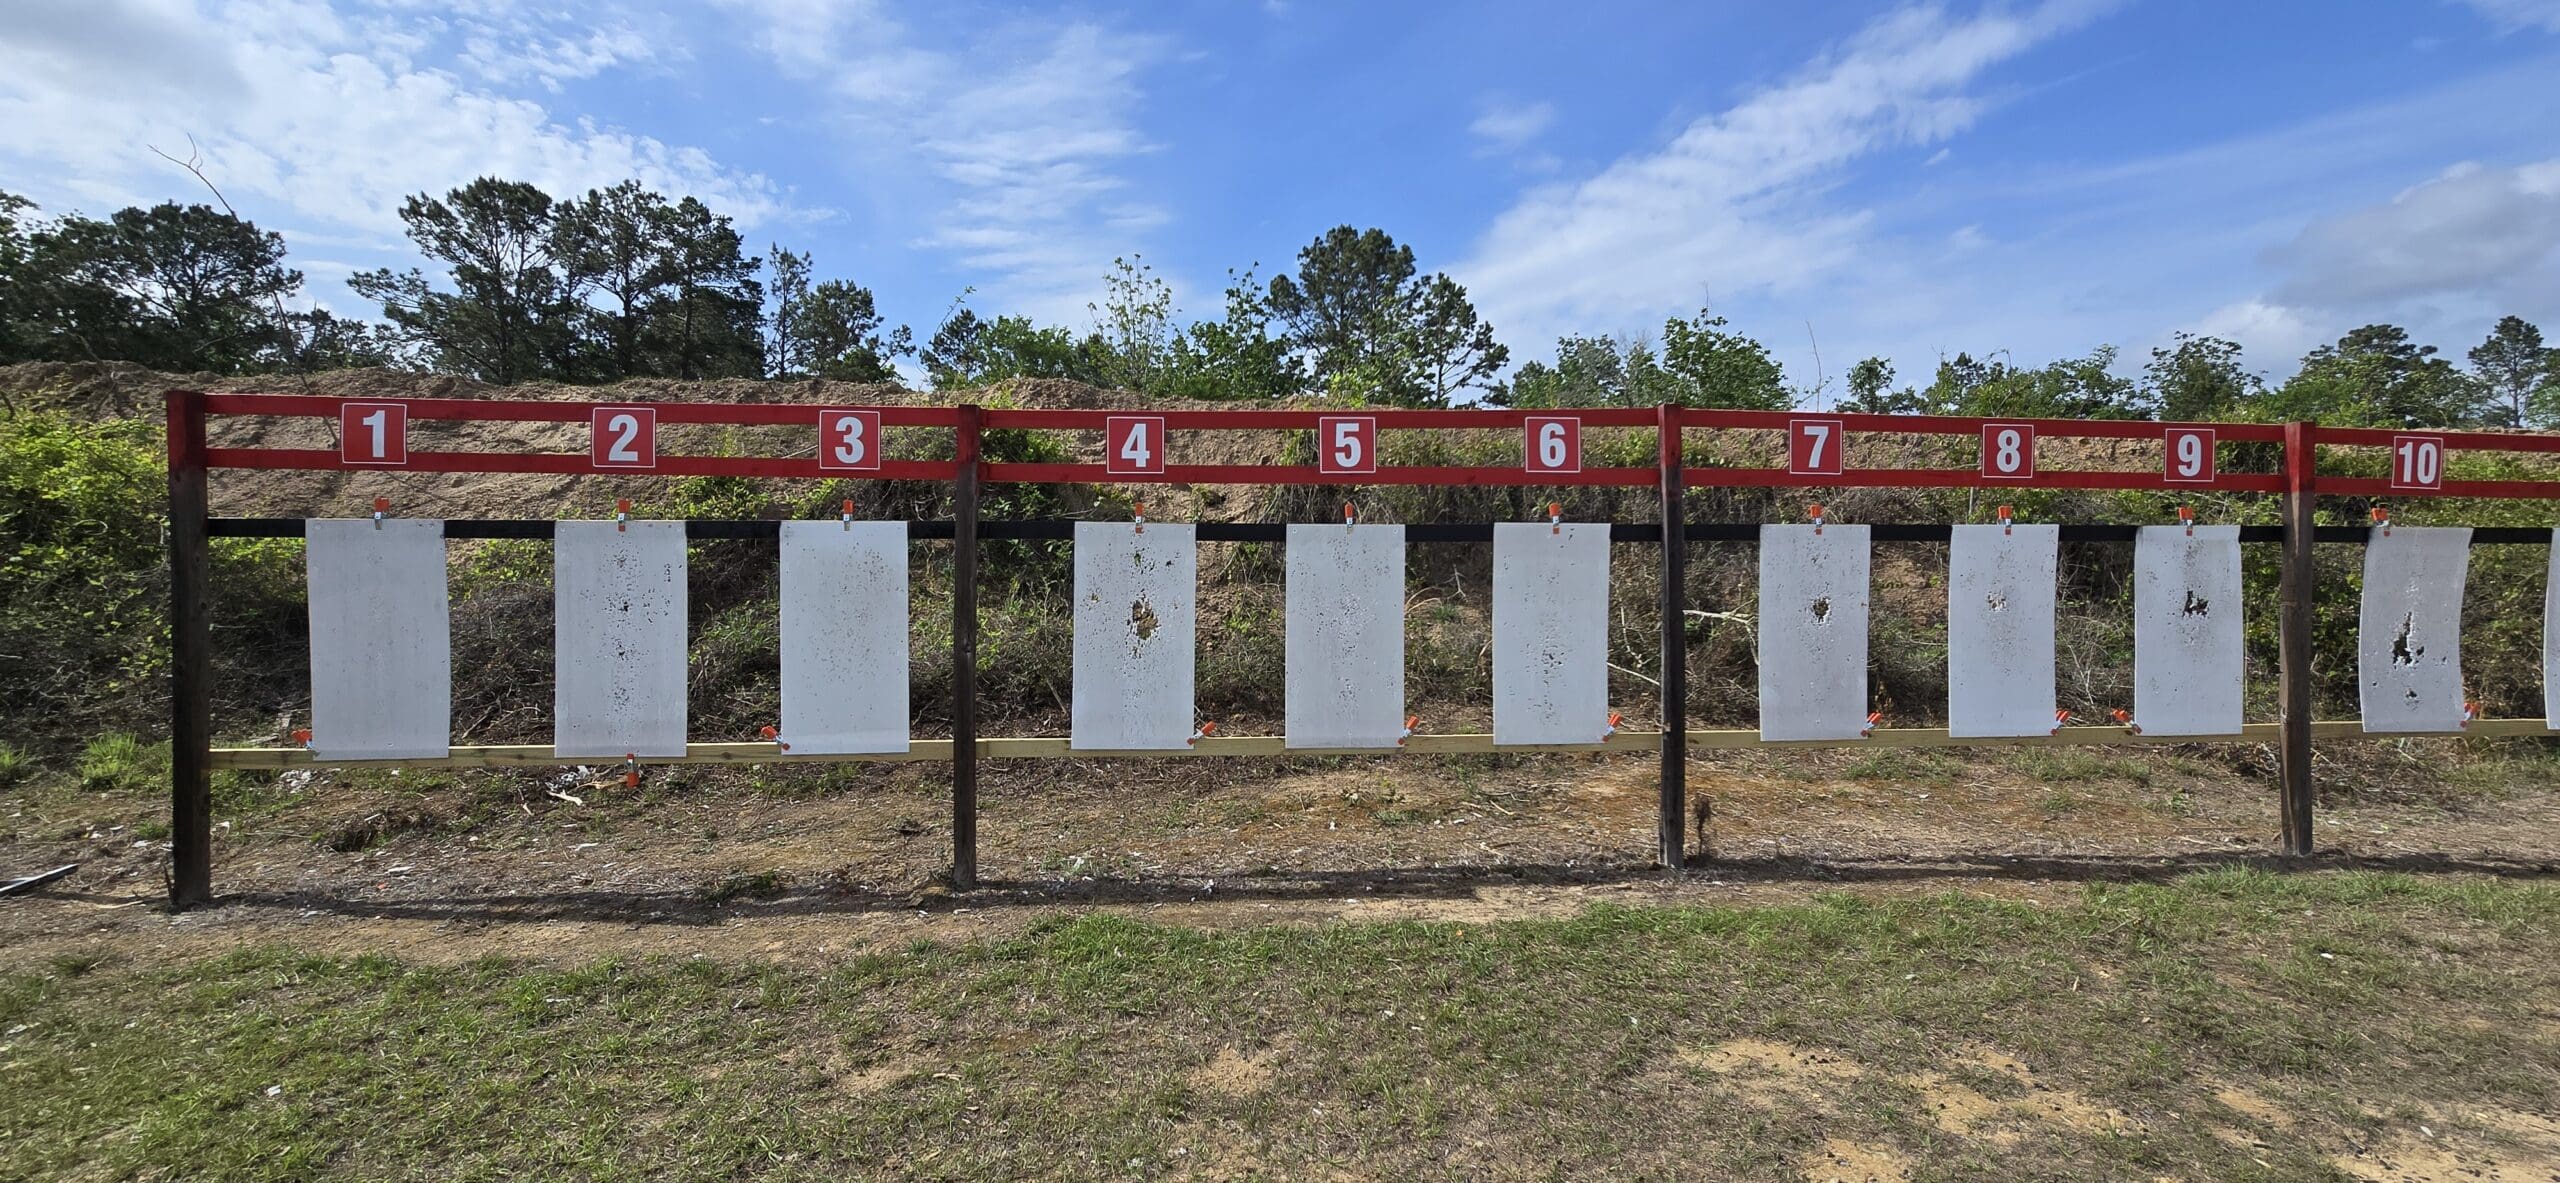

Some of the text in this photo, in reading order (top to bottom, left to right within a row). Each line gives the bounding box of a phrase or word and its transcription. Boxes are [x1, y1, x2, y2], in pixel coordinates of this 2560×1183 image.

[362, 410, 386, 458] 1
[608, 415, 639, 462] 2
[834, 416, 865, 464] 3
[1121, 423, 1151, 468] 4
[1334, 422, 1362, 468] 5
[1539, 422, 1566, 468] 6
[1804, 425, 1829, 468] 7
[1996, 429, 2021, 473] 8
[2177, 434, 2202, 477] 9
[2398, 441, 2437, 484] 10
